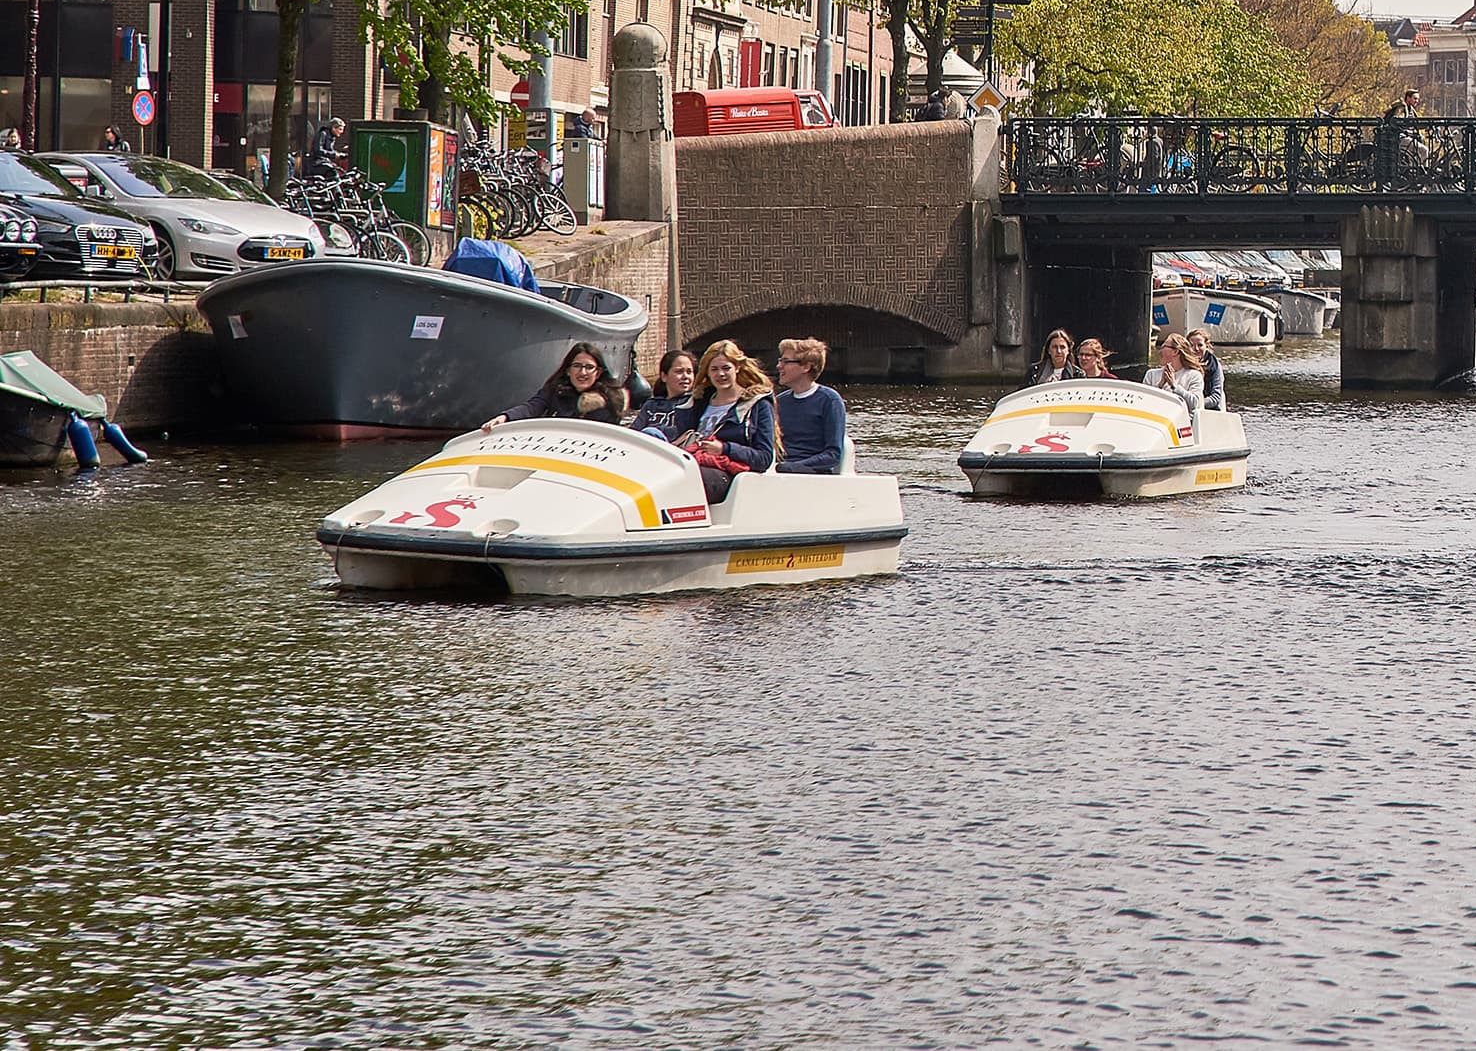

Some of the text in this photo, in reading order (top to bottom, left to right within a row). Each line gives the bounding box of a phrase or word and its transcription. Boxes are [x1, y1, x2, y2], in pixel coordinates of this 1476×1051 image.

[479, 436, 630, 457] CANAL TOURS
[480, 444, 609, 462] AMSTERDAM
[735, 552, 838, 568] CANAL TOURS AMSTERDAM
